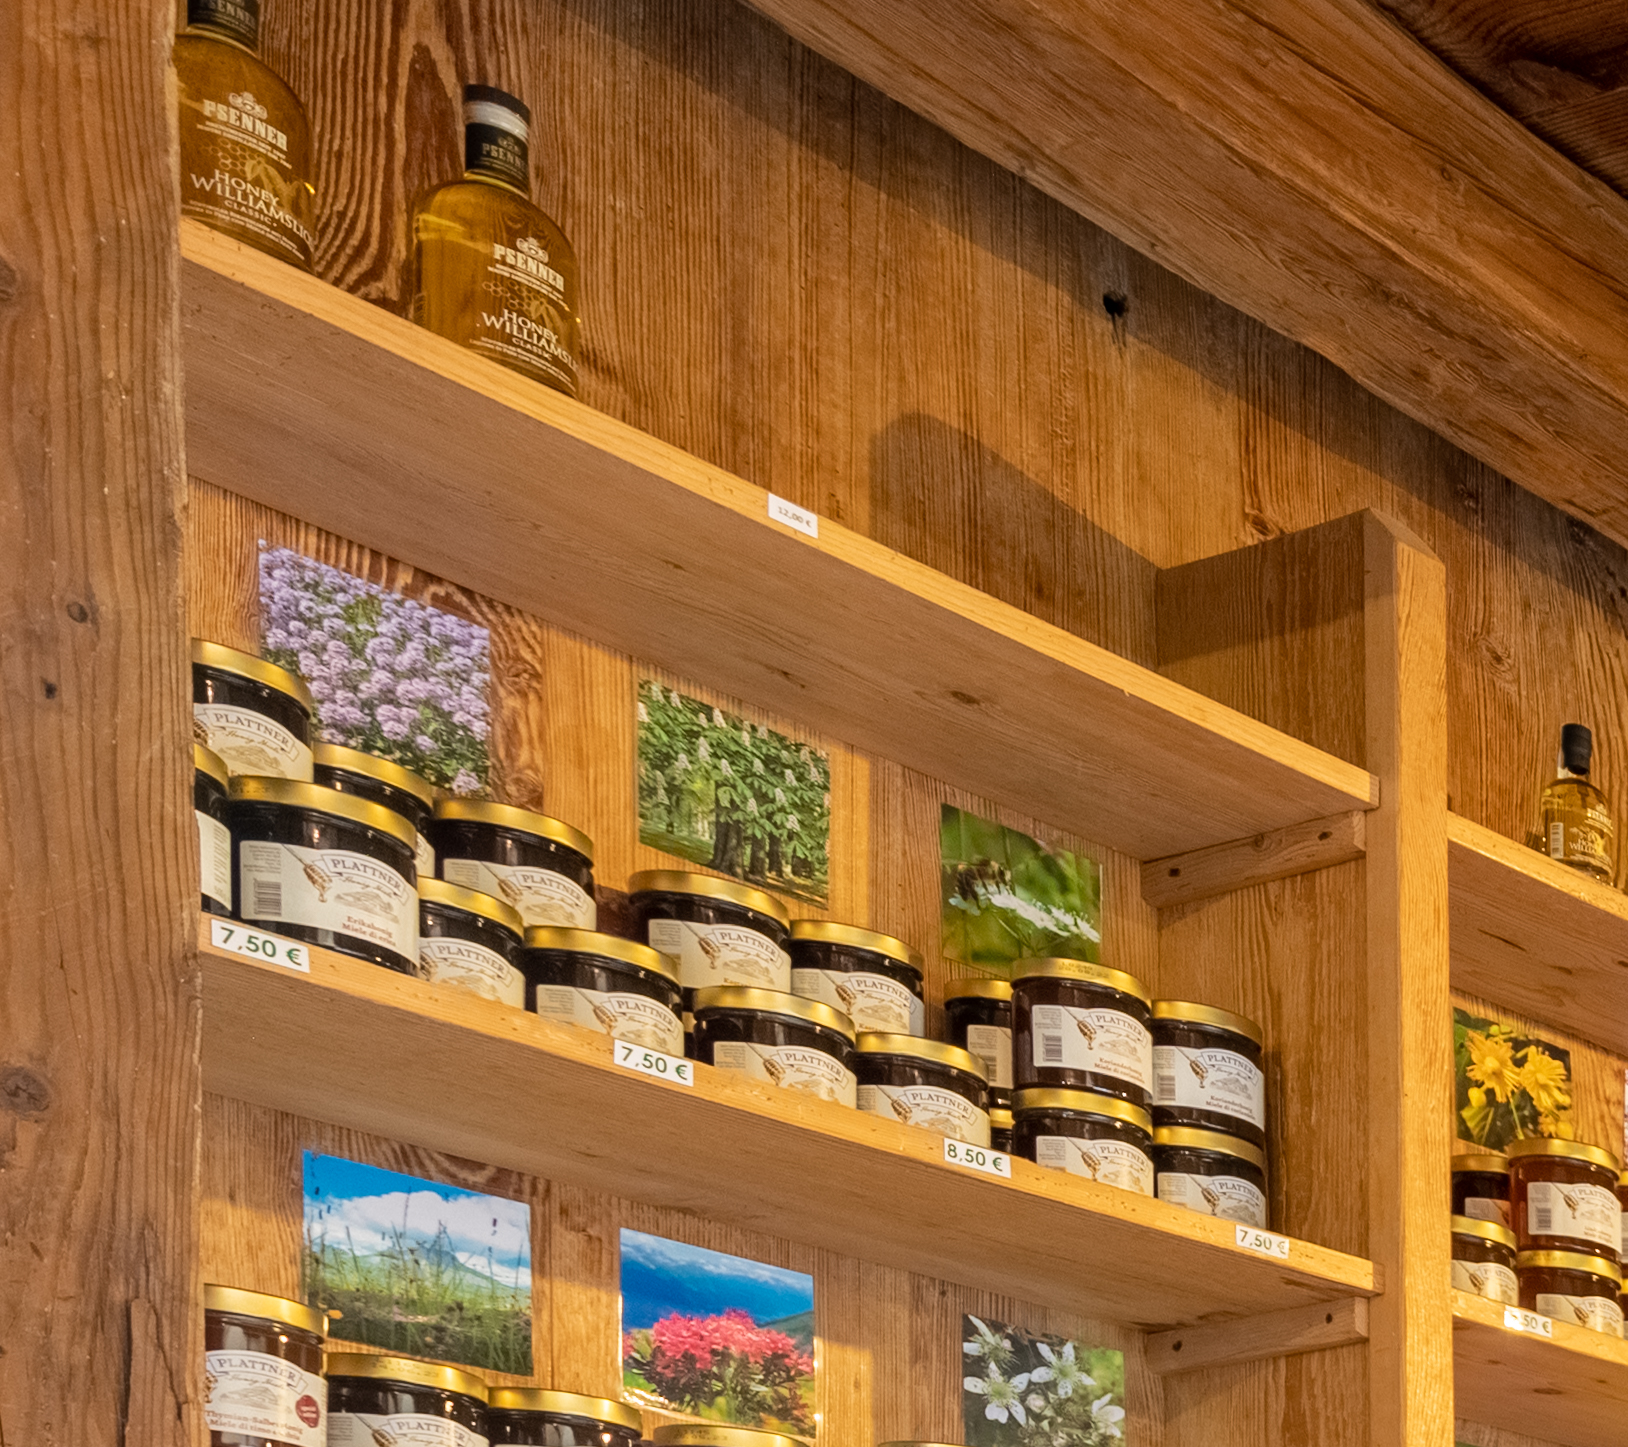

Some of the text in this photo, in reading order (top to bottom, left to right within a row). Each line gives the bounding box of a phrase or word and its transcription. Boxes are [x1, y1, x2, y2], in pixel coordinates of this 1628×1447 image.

[203, 99, 288, 151] PSENNER
[214, 168, 278, 207] HONEY
[224, 200, 272, 225] CLASSIC
[493, 242, 565, 293] PSENNER
[503, 308, 558, 343] HONEY
[214, 712, 289, 747] PLATTNER
[331, 859, 401, 890] PLATTNER
[522, 874, 582, 902] PLATTNER
[219, 925, 302, 967] 7,50 €
[720, 932, 777, 958] PLATTNER
[437, 943, 505, 978] PLATTNER
[855, 979, 911, 1004] PLATTNER
[617, 1000, 675, 1027] PLATTNER
[1095, 1014, 1143, 1037] PLATTNER
[621, 1045, 688, 1080] 7,50 €
[785, 1052, 843, 1079] PLATTNER
[1208, 1053, 1254, 1076] PLATTNER
[911, 1091, 970, 1117] PLATTNER
[947, 1143, 1003, 1171] 8,50 €
[1100, 1146, 1147, 1169] PLATTNER
[1218, 1180, 1260, 1202] PLATTNER
[1239, 1229, 1287, 1254] 7,50 €
[216, 1358, 296, 1381] PLATTNER
[396, 1420, 466, 1442] PLATTNER
